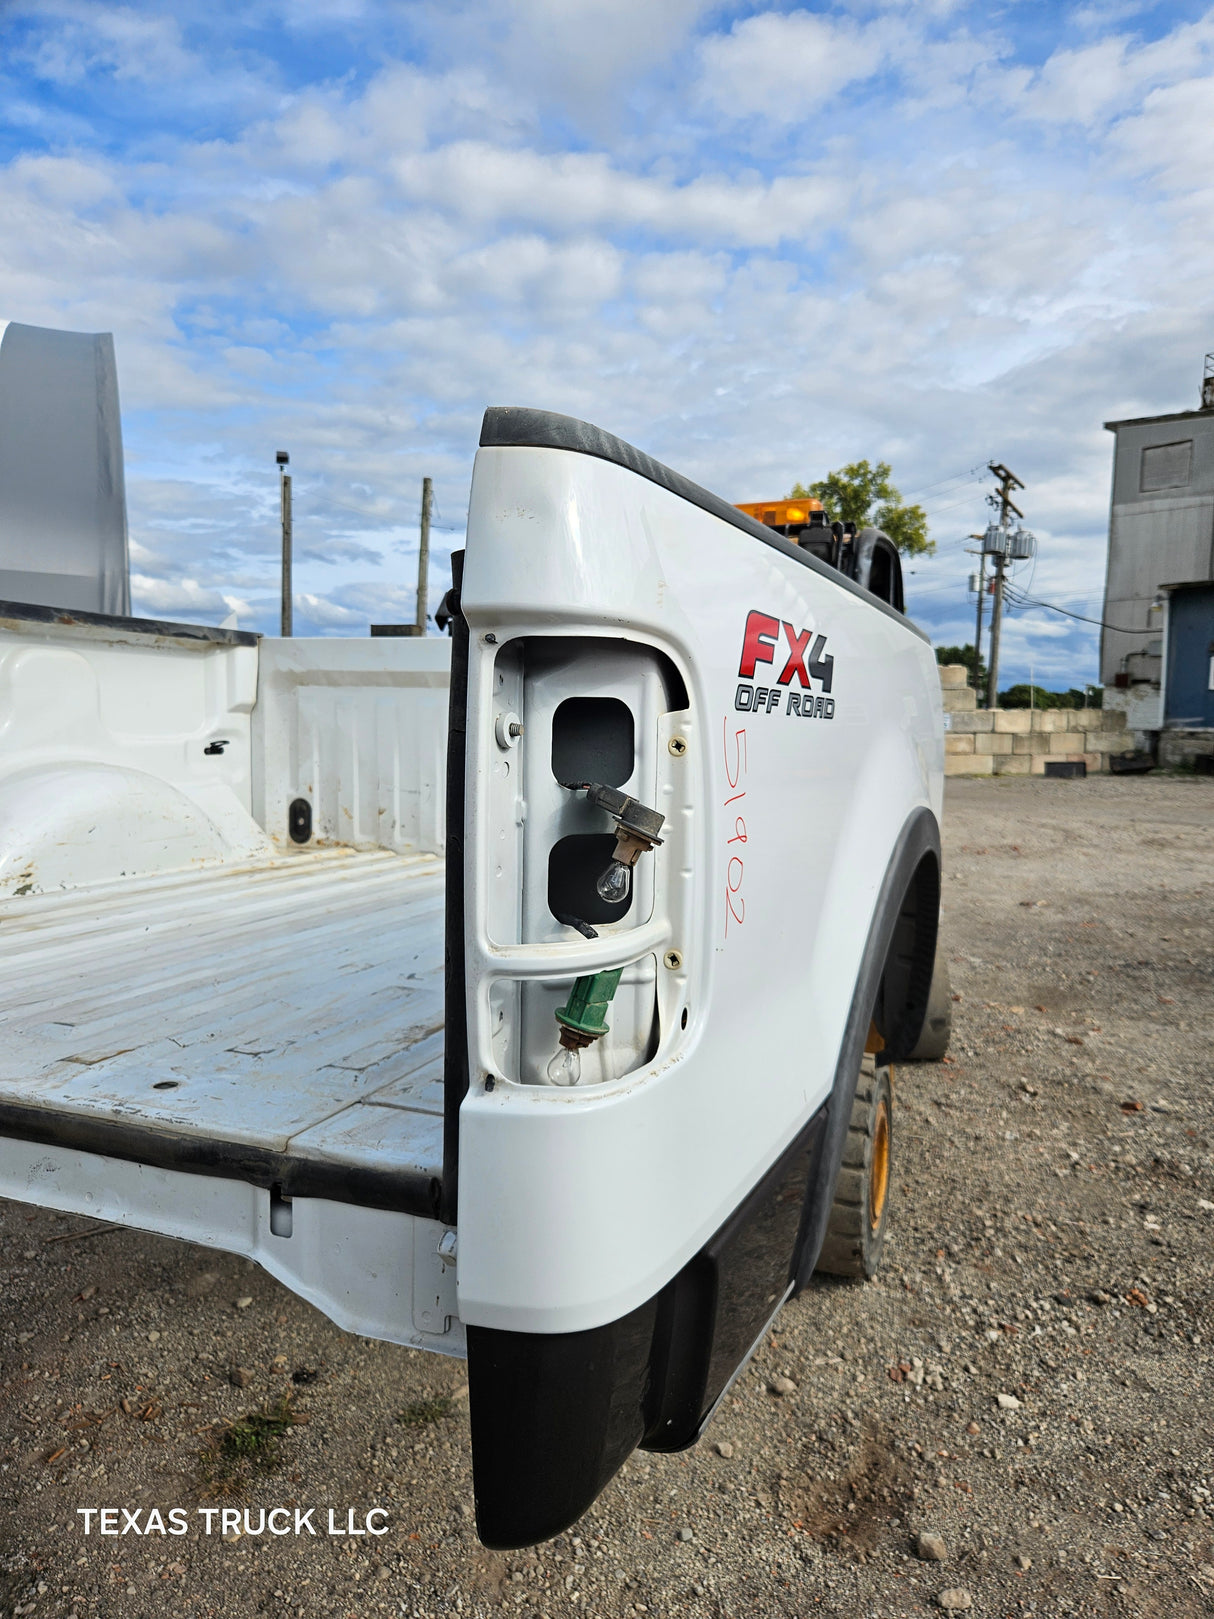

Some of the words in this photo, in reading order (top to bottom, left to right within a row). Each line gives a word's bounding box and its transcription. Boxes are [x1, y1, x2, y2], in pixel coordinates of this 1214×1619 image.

[738, 609, 834, 693] FX4
[734, 684, 781, 713] OFF
[786, 692, 835, 719] ROAD
[723, 715, 747, 939] 51902
